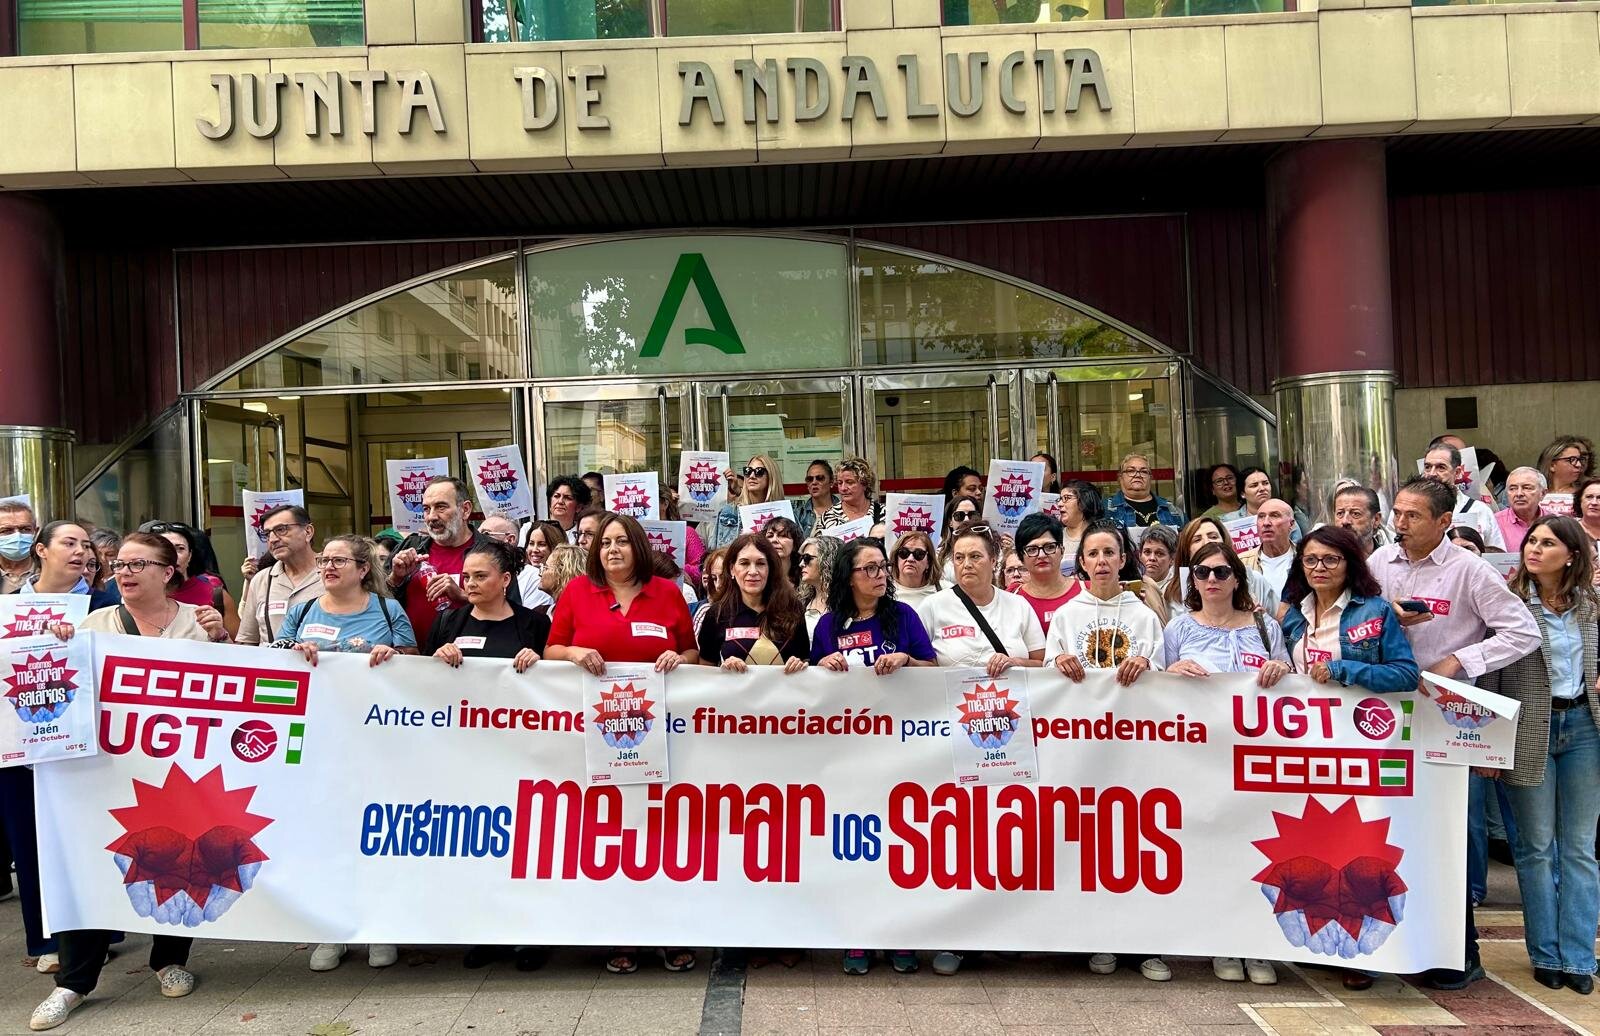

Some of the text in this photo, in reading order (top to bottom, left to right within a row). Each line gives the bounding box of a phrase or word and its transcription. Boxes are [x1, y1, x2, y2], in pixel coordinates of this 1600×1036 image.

[196, 48, 1112, 141] JUNTA DE ANDALUCIA
[942, 626, 963, 637] UGT
[1347, 623, 1374, 640] UGT
[16, 667, 65, 685] mejorar
[111, 665, 246, 703] CCOO
[18, 687, 66, 707] salarios
[603, 697, 643, 712] mejorar
[967, 697, 1007, 712] mejorar
[364, 703, 425, 727] Ante
[431, 705, 452, 727] el
[692, 707, 893, 736] financiación
[901, 718, 951, 742] para
[605, 717, 644, 733] salarios
[970, 717, 1010, 732] salarios
[1233, 695, 1342, 739] UGT
[33, 724, 59, 735] Jaén
[99, 709, 223, 760] UGT
[1456, 730, 1480, 741] Jaén
[40, 734, 70, 742] Octubre
[1463, 741, 1492, 749] Octubre
[617, 750, 639, 759] Jaén
[984, 750, 1006, 760] Jaén
[1243, 754, 1370, 786] CCOO
[359, 779, 1182, 895] exigimos mejorar los salarios
